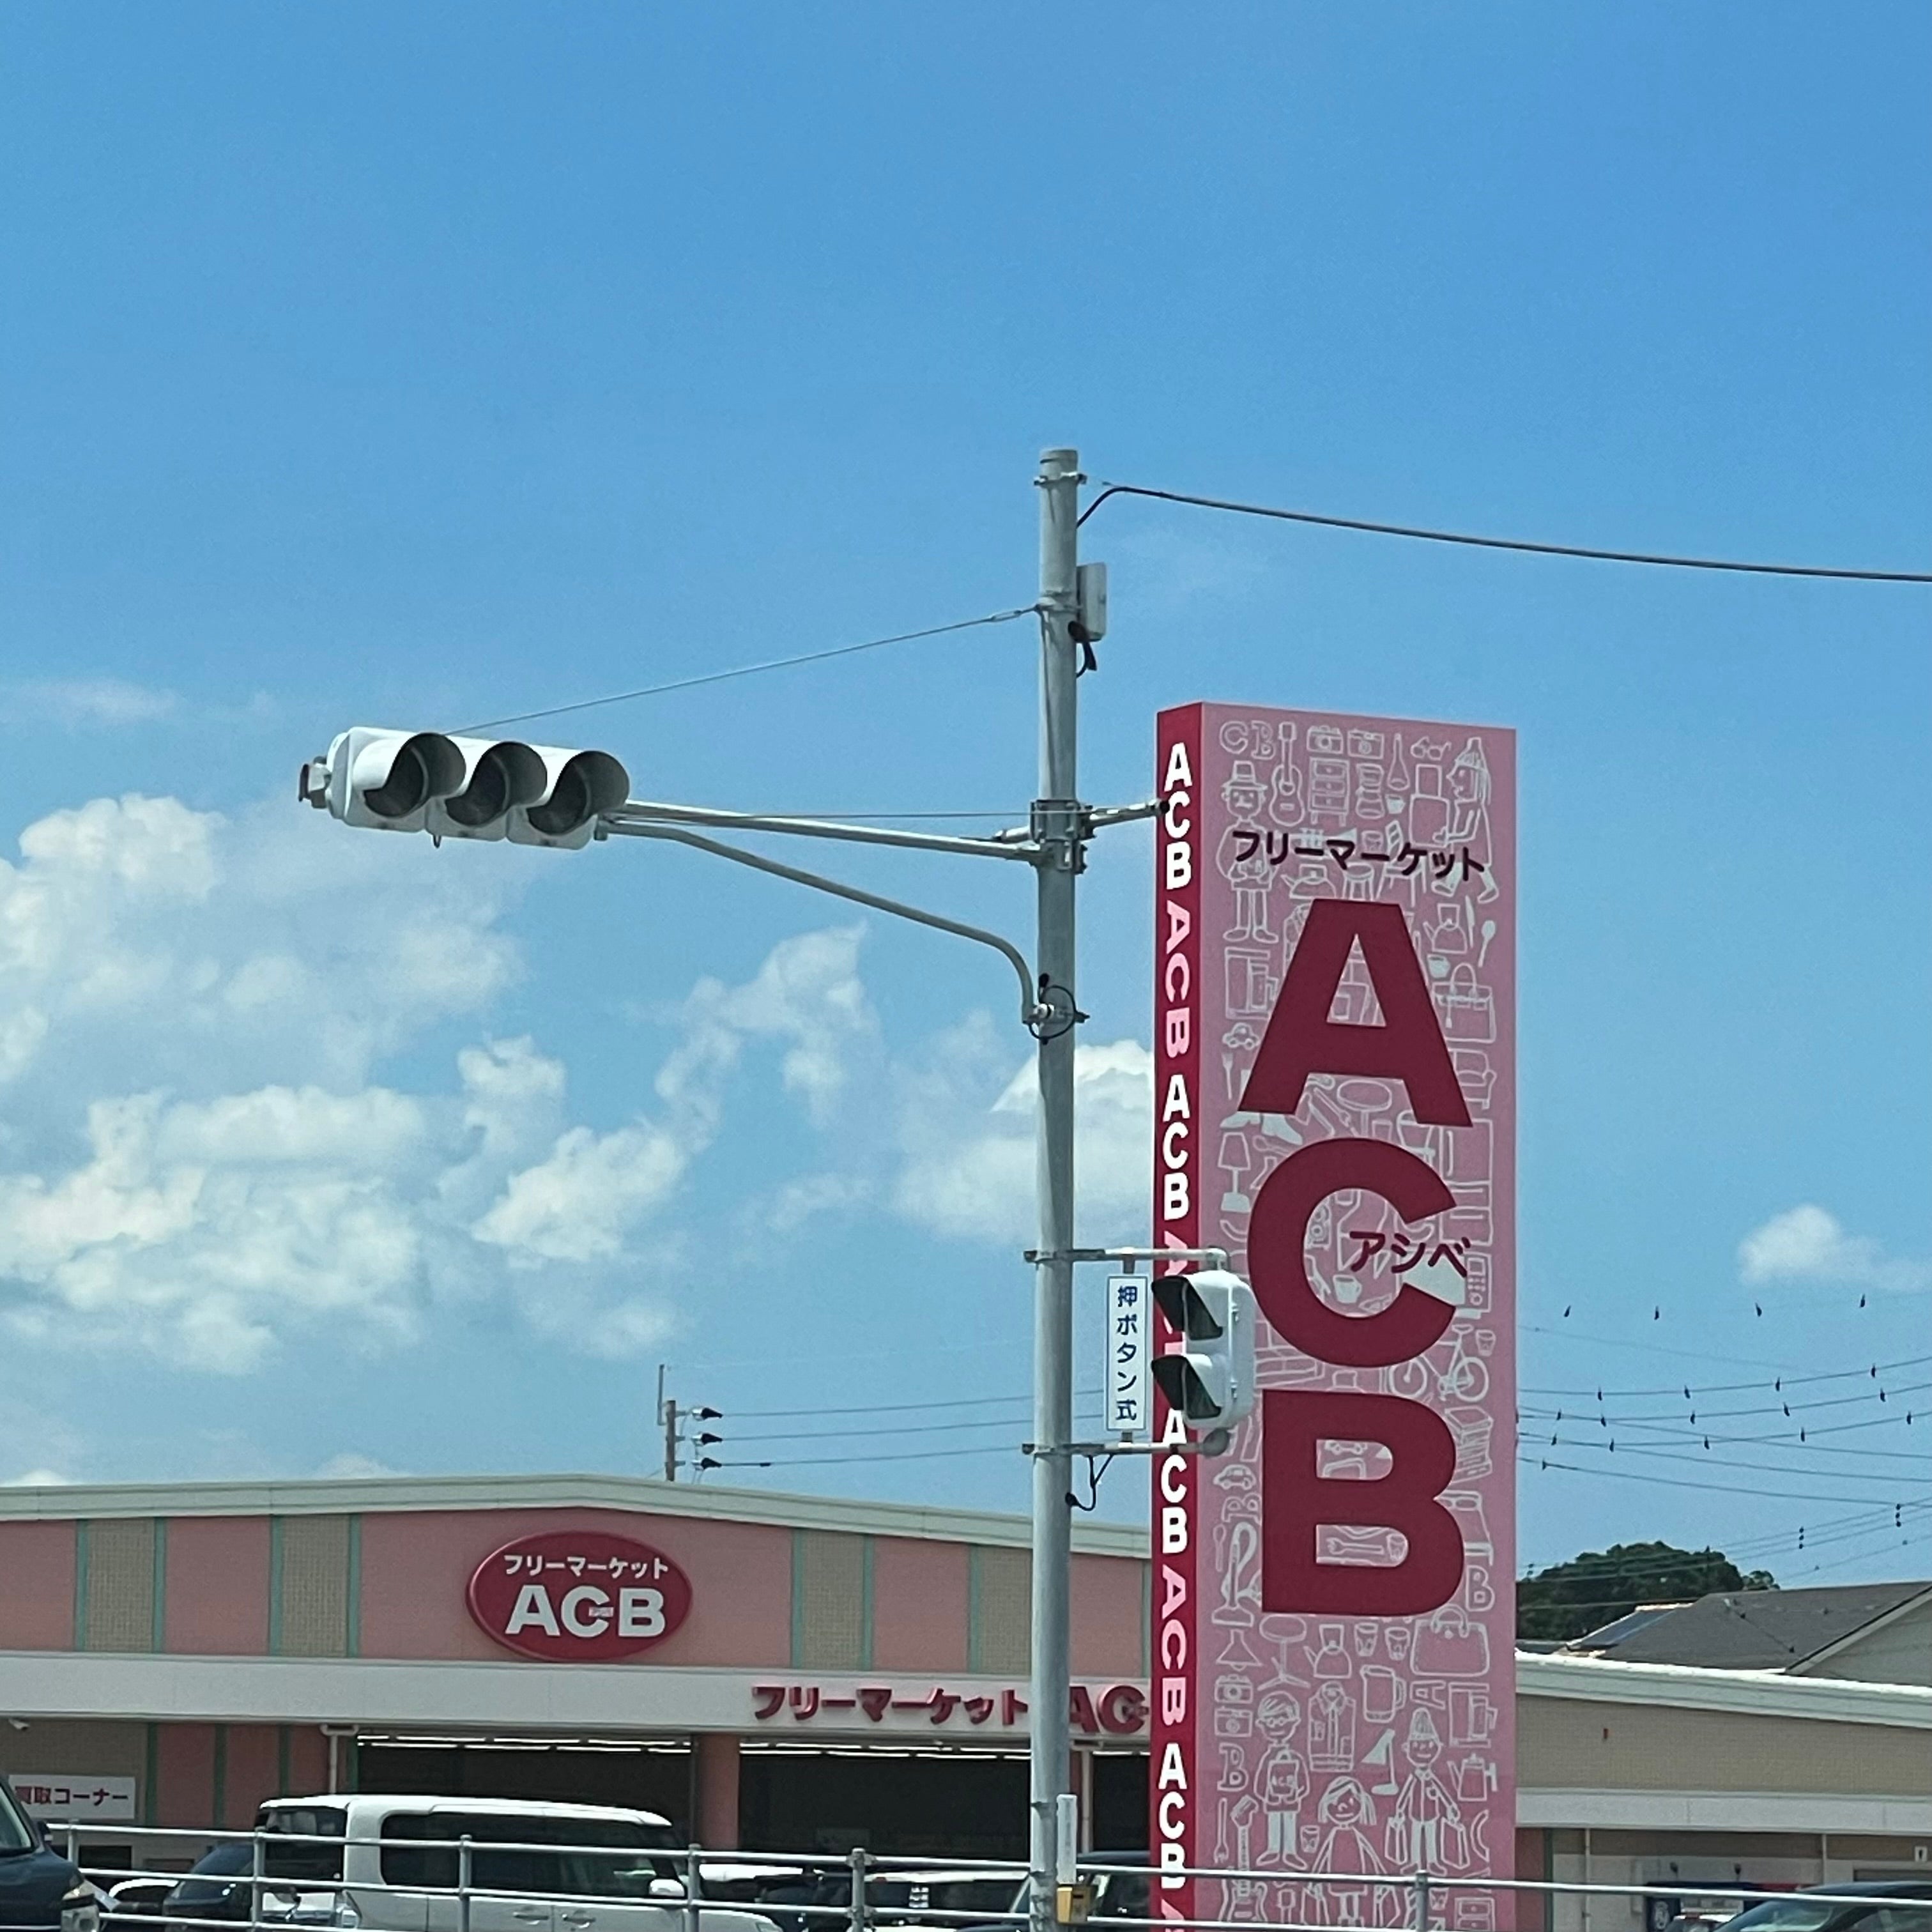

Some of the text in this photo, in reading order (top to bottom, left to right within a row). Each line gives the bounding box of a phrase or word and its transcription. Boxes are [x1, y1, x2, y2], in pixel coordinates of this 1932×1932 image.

[1163, 742, 1193, 890] ACB
[1232, 831, 1485, 882] フリーマーケット
[1165, 900, 1190, 1058] ACB
[1162, 1074, 1190, 1220] ACB
[1238, 898, 1473, 1616] ACB
[1349, 1230, 1471, 1277] アシベ
[1116, 1285, 1138, 1421] 押ボタン式
[1161, 1407, 1188, 1554] ACB
[503, 1554, 669, 1580] フリーマーケット
[505, 1584, 666, 1638] ACB
[752, 1685, 1029, 1726] フリーマーケット
[1069, 1685, 1147, 1734] AC
[1162, 1563, 1186, 1726] ACB
[1158, 1743, 1187, 1889] ACB
